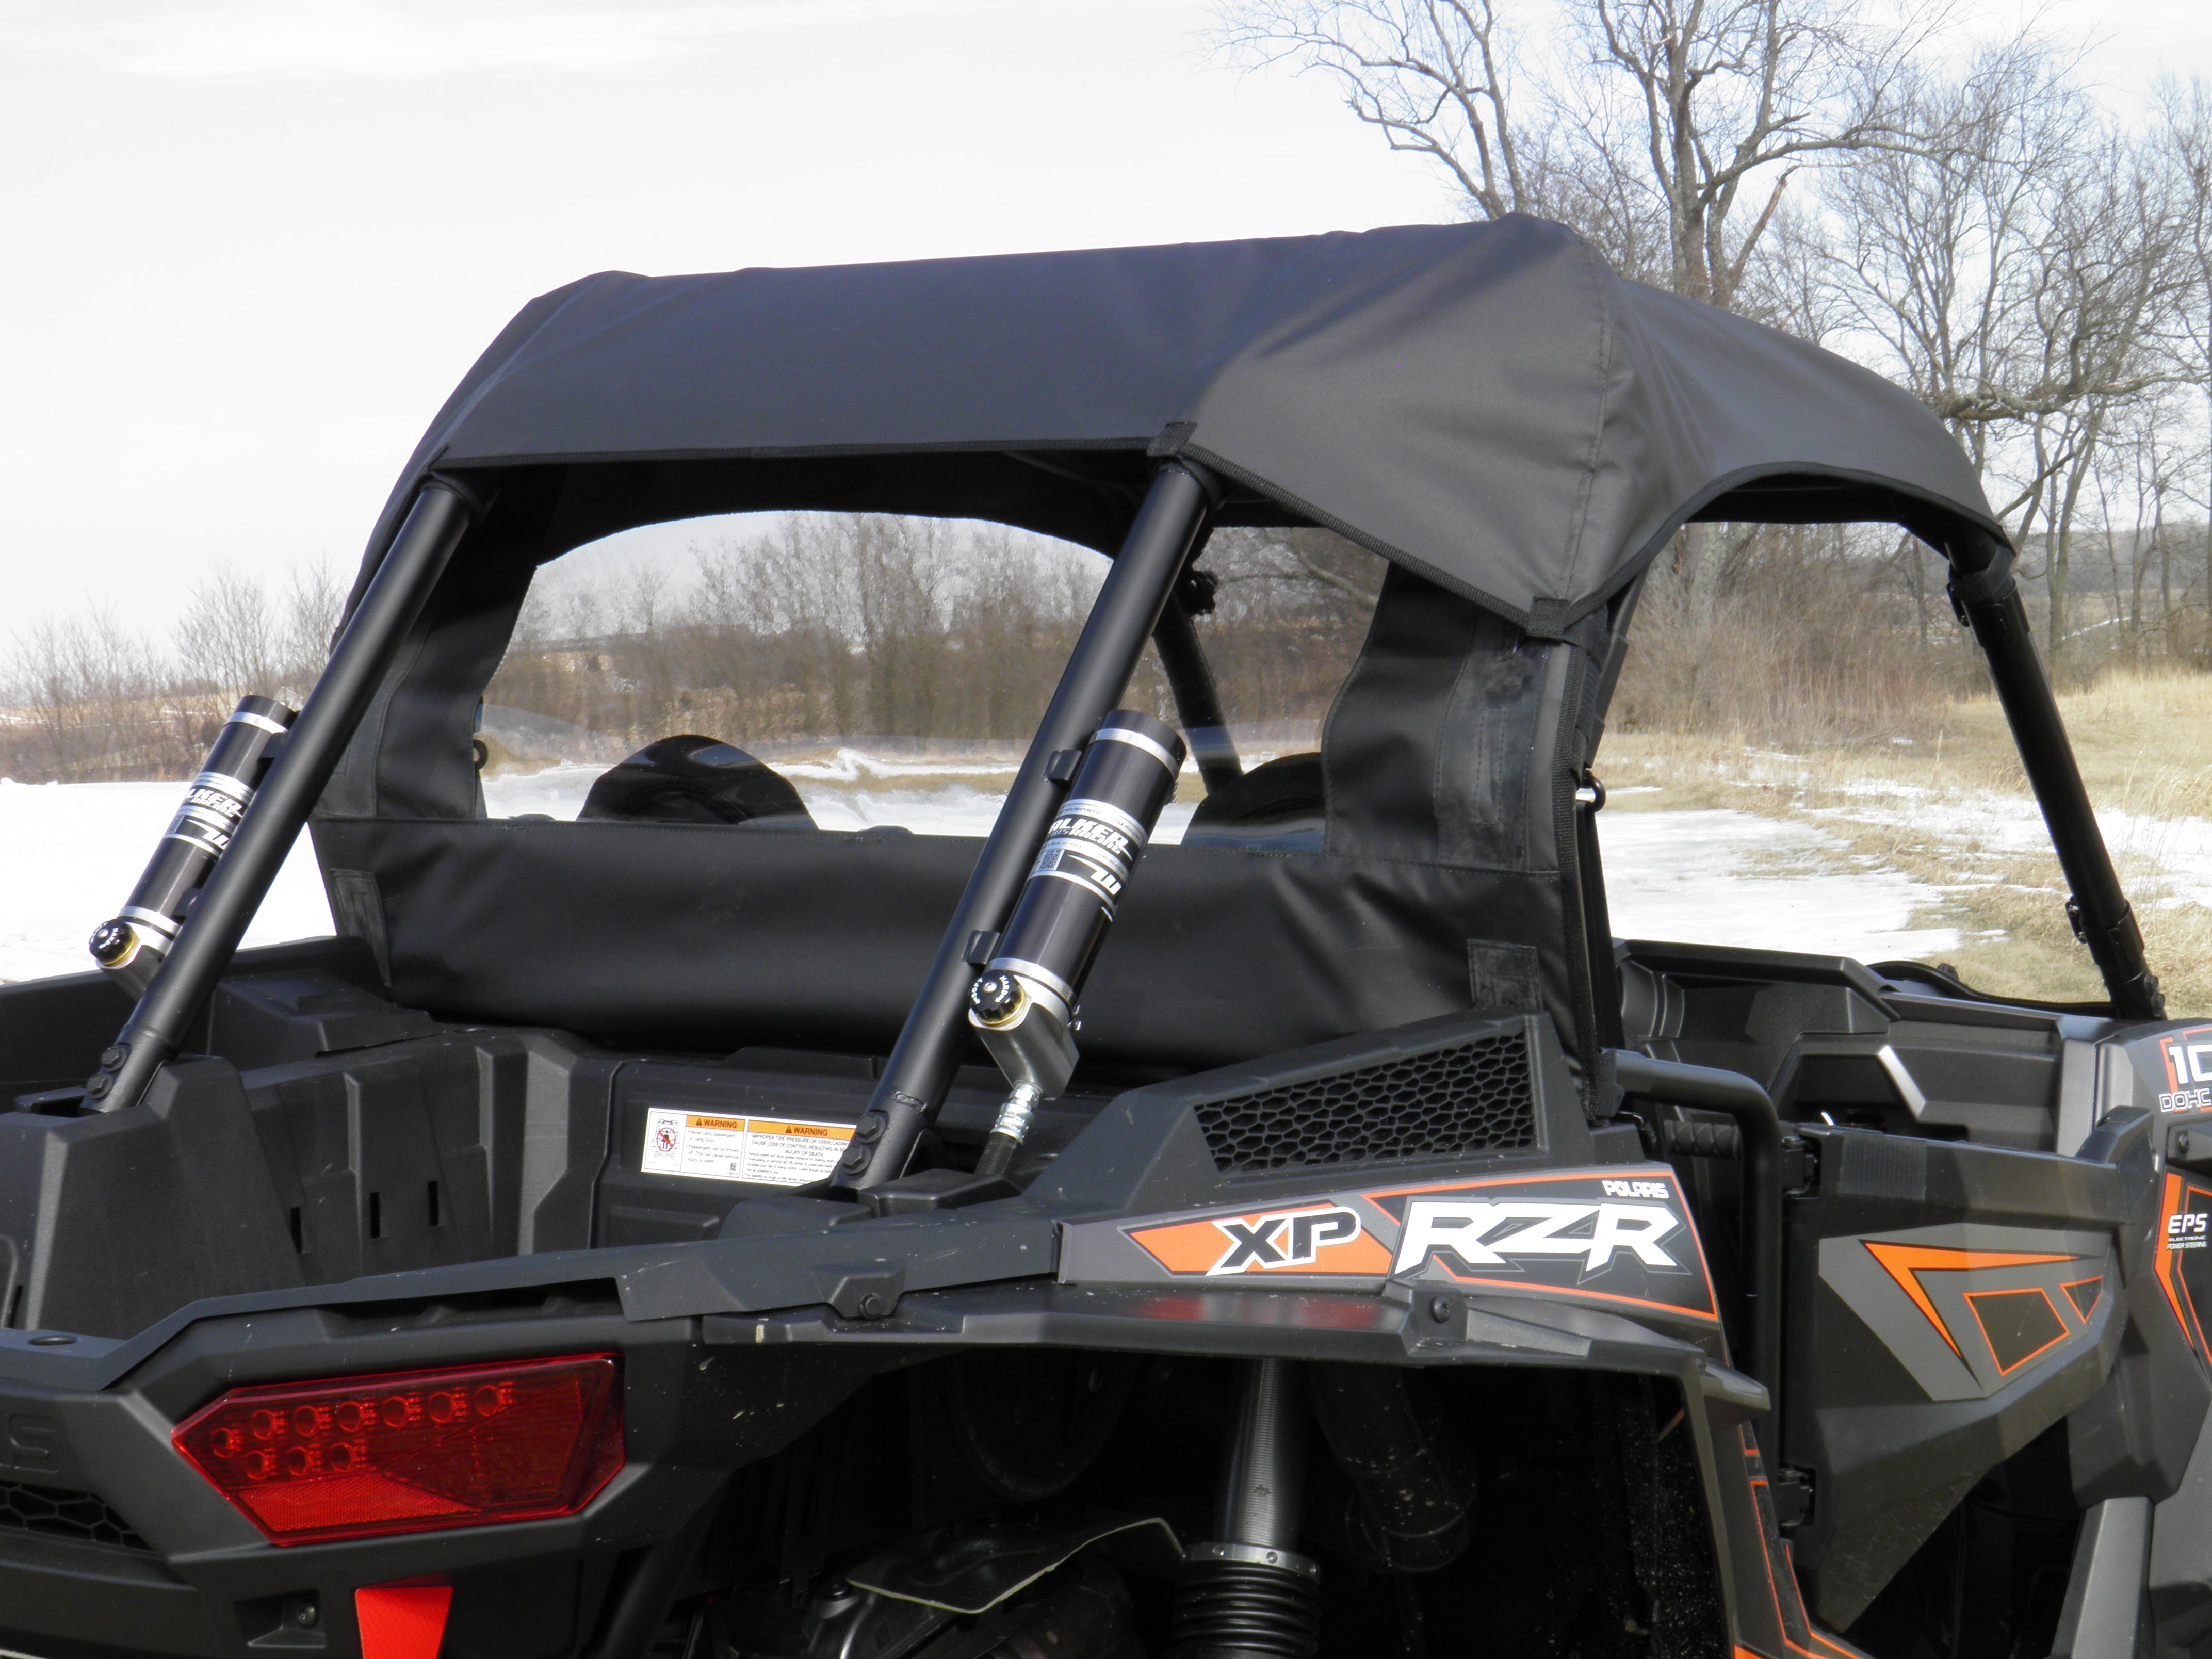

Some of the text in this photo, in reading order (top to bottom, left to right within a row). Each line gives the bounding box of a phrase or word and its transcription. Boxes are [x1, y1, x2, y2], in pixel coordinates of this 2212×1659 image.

[186, 788, 242, 815] LKER
[1048, 818, 1130, 854] ALKER
[2158, 1088, 2212, 1112] DOHC
[704, 1119, 737, 1129] WARNING
[793, 1126, 827, 1136] WARNING
[1602, 1180, 1669, 1199] POLARIS
[2168, 1213, 2208, 1233] EPS
[1207, 1206, 1361, 1276] XP
[1395, 1201, 1680, 1275] RZR
